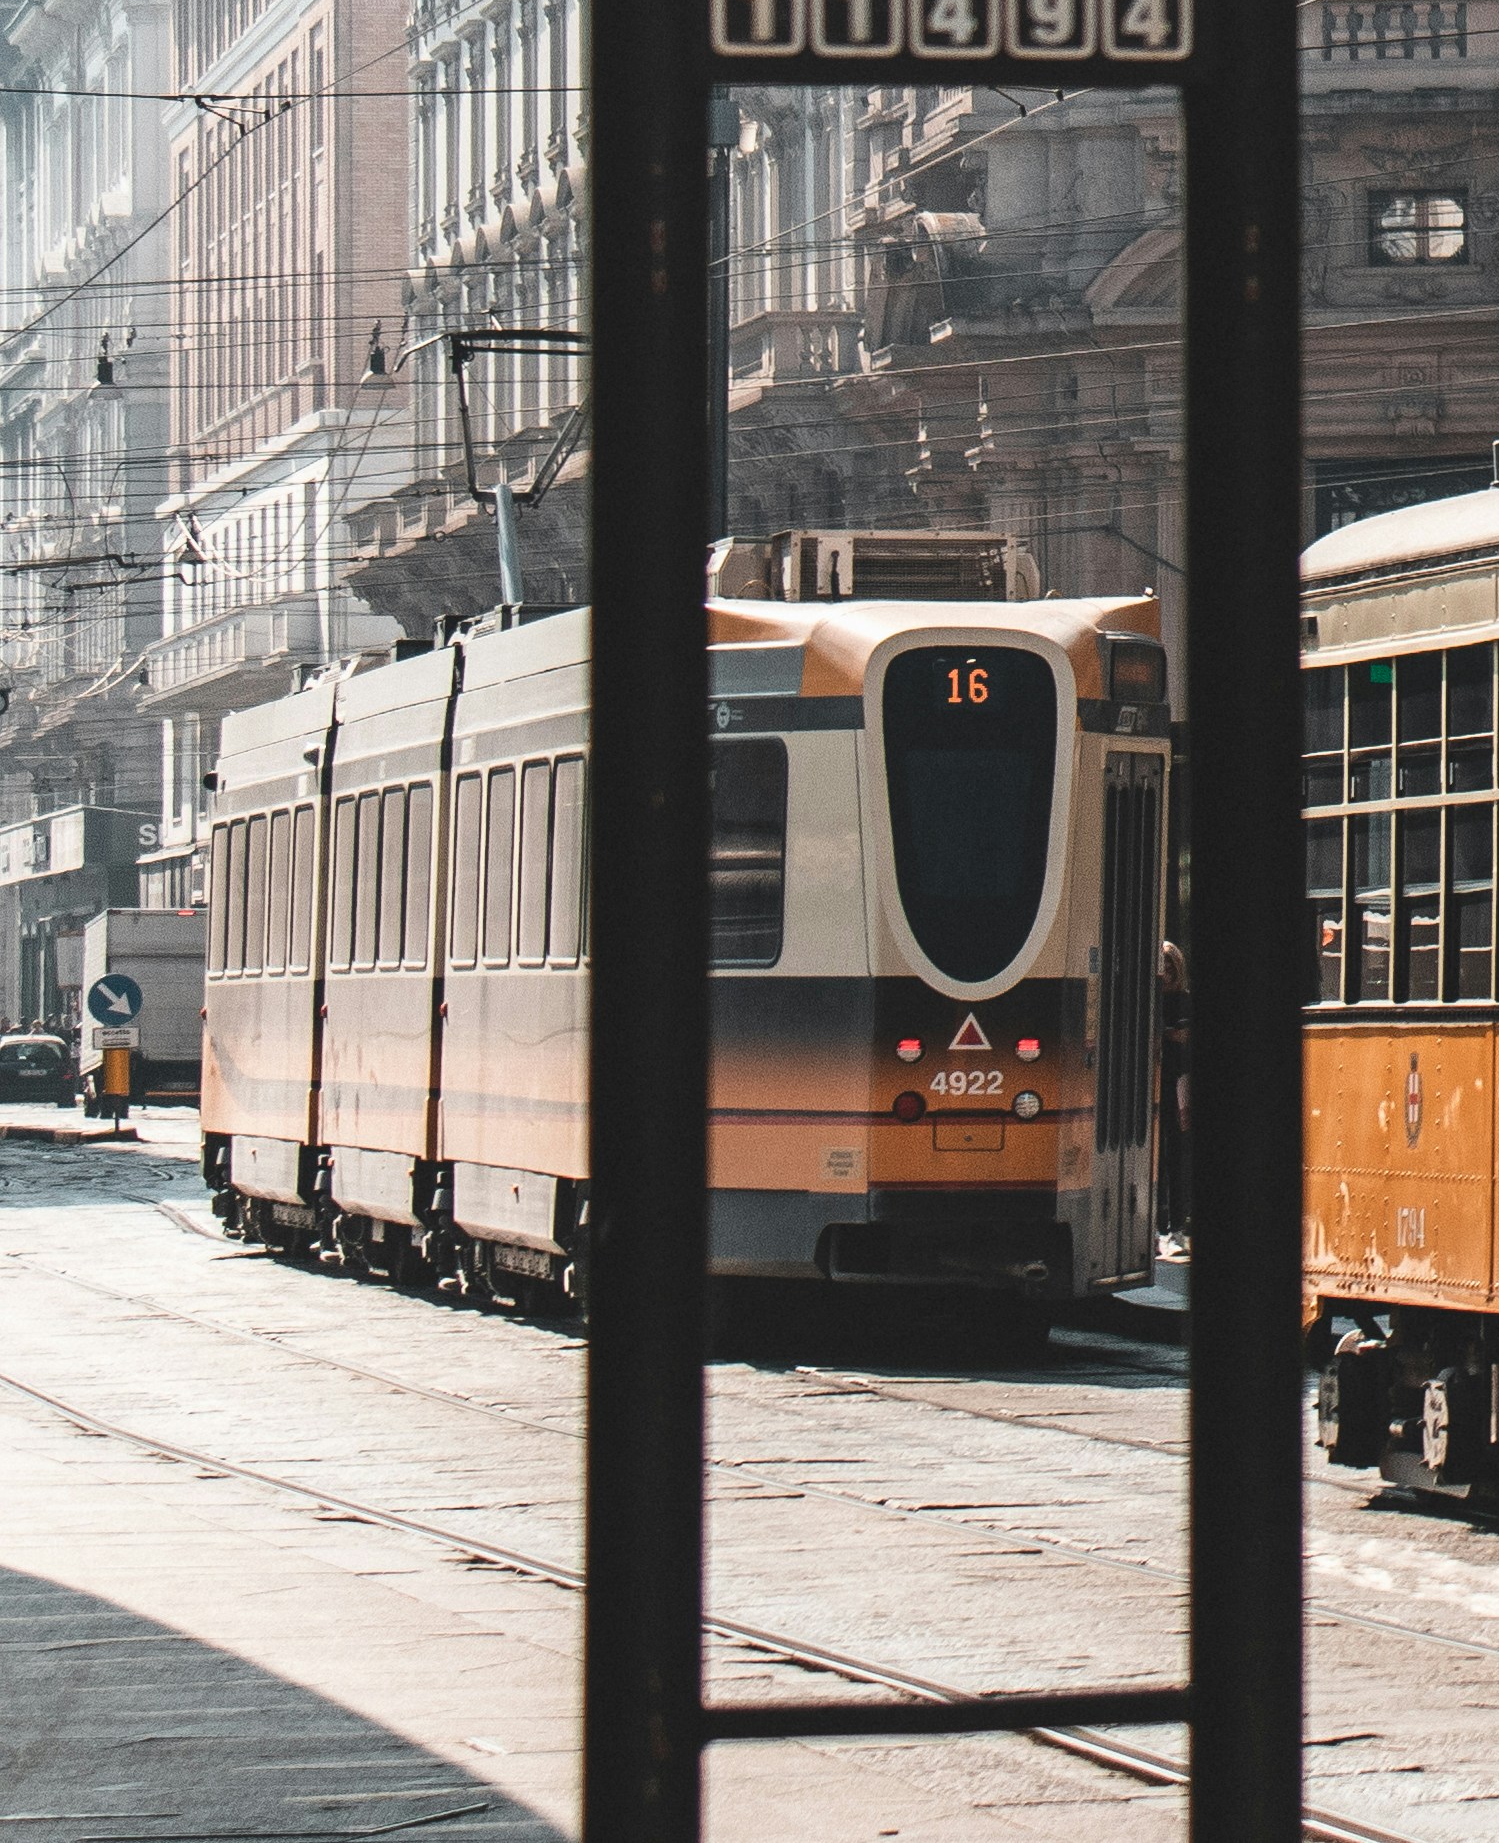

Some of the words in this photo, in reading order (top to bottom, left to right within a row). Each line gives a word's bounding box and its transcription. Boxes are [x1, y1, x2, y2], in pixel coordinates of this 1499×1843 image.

[947, 667, 989, 705] 16
[929, 1069, 1004, 1097] 4922
[1395, 1206, 1426, 1250] 1794
